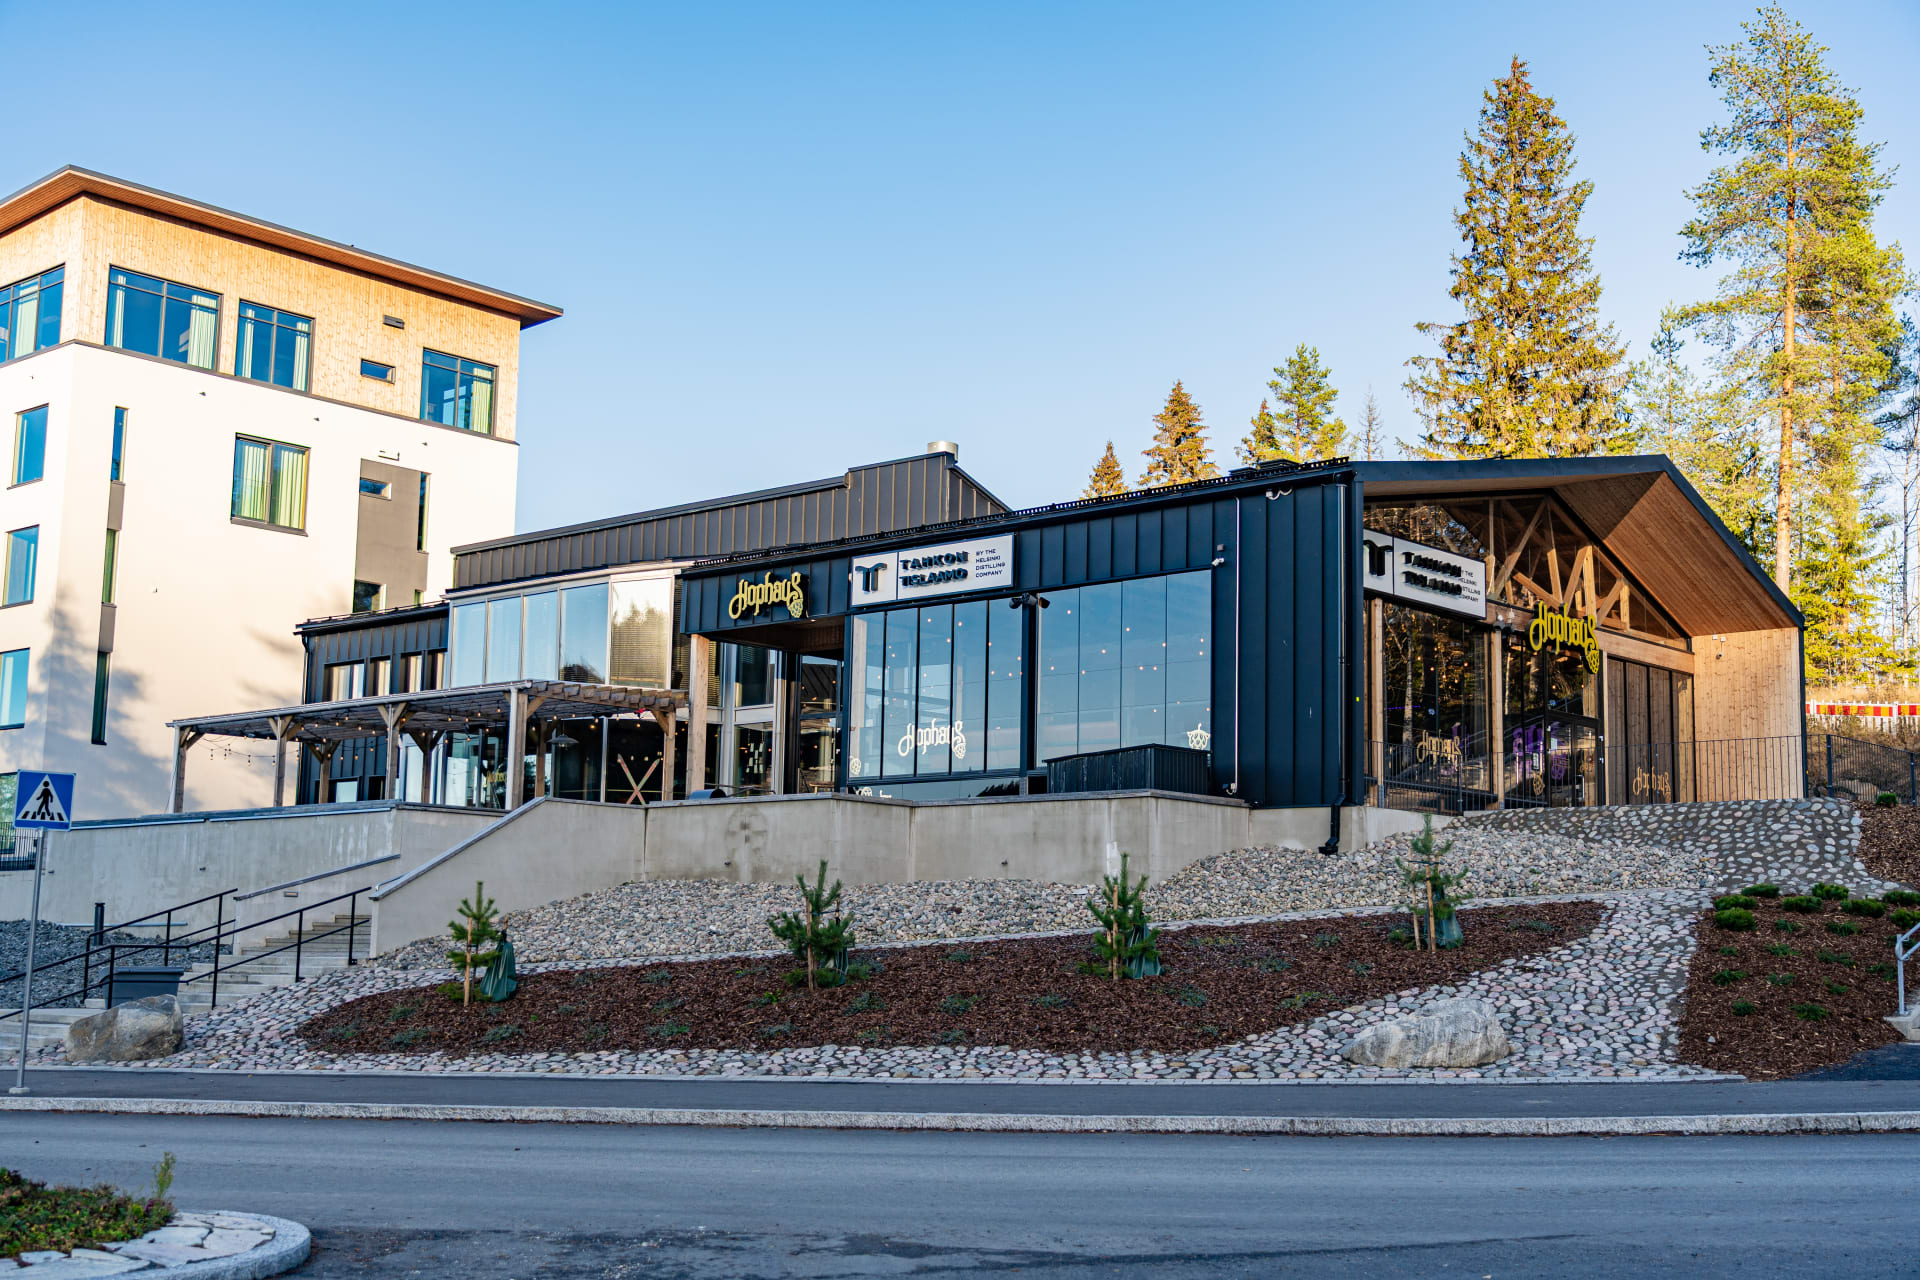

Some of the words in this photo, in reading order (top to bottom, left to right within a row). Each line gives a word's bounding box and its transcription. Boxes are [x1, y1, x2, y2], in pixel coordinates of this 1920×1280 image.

[900, 551, 968, 570] TAHKON
[976, 555, 1001, 563] HELSINKI
[976, 562, 1006, 570] DISTILLING
[899, 568, 968, 586] TISLAAMO
[976, 570, 1003, 578] COMPANY
[729, 572, 803, 619] Hophaus
[1530, 600, 1598, 656] Hophaus
[898, 718, 966, 757] Hophaus
